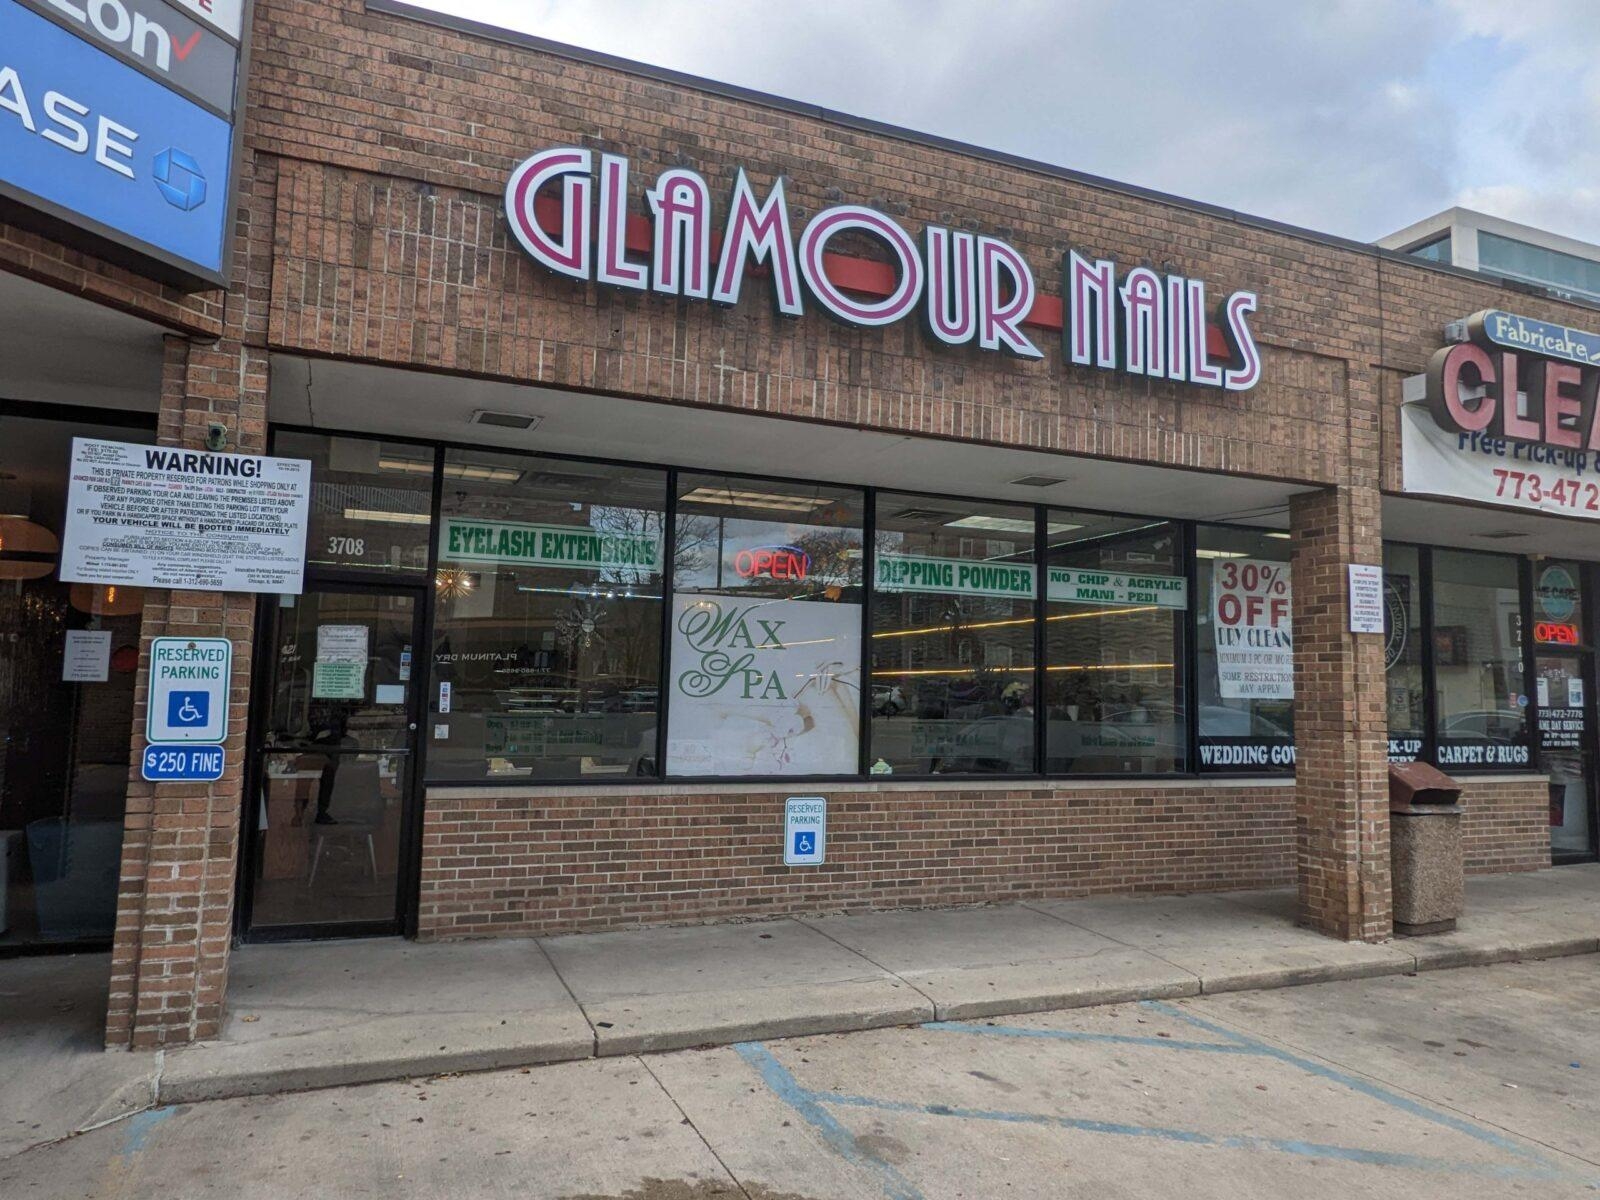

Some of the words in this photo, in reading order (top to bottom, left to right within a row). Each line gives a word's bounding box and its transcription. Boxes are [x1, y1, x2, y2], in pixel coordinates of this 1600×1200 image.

[505, 148, 1042, 360] GLAMOUR
[1069, 250, 1262, 391] NAILS
[1458, 430, 1506, 456] Free
[145, 450, 262, 478] WARNING!
[121, 519, 159, 527] VEHICLE
[161, 521, 182, 529] WILL
[199, 523, 232, 531] BOOTED
[235, 525, 290, 535] IMMEDIATELY
[328, 537, 365, 556] 3708
[448, 525, 536, 558] EYELASH
[540, 533, 656, 565] EXTENSIONS
[735, 549, 807, 580] OPEN
[878, 559, 953, 587] DIPPING
[958, 564, 1032, 593] POWDER
[1127, 578, 1182, 591] ACRYLIC
[1221, 561, 1287, 595] 30%
[1076, 588, 1115, 600] MANI
[1127, 591, 1158, 603] PEDI
[1218, 593, 1289, 628] OFF
[1218, 627, 1242, 647] DRY
[1536, 623, 1577, 645] OPEN
[158, 648, 225, 662] RESERVED
[161, 666, 219, 680] PARKING
[1222, 672, 1242, 681] SOME
[1239, 684, 1254, 694] MAY
[1257, 684, 1281, 694] APPLY
[191, 752, 221, 773] FINE
[1200, 745, 1268, 765] WEDDING
[1438, 746, 1482, 764] CARPET
[1486, 746, 1495, 763] &
[1498, 746, 1529, 763] RUGS
[788, 804, 823, 813] RESERVED
[790, 816, 821, 824] PARKING
